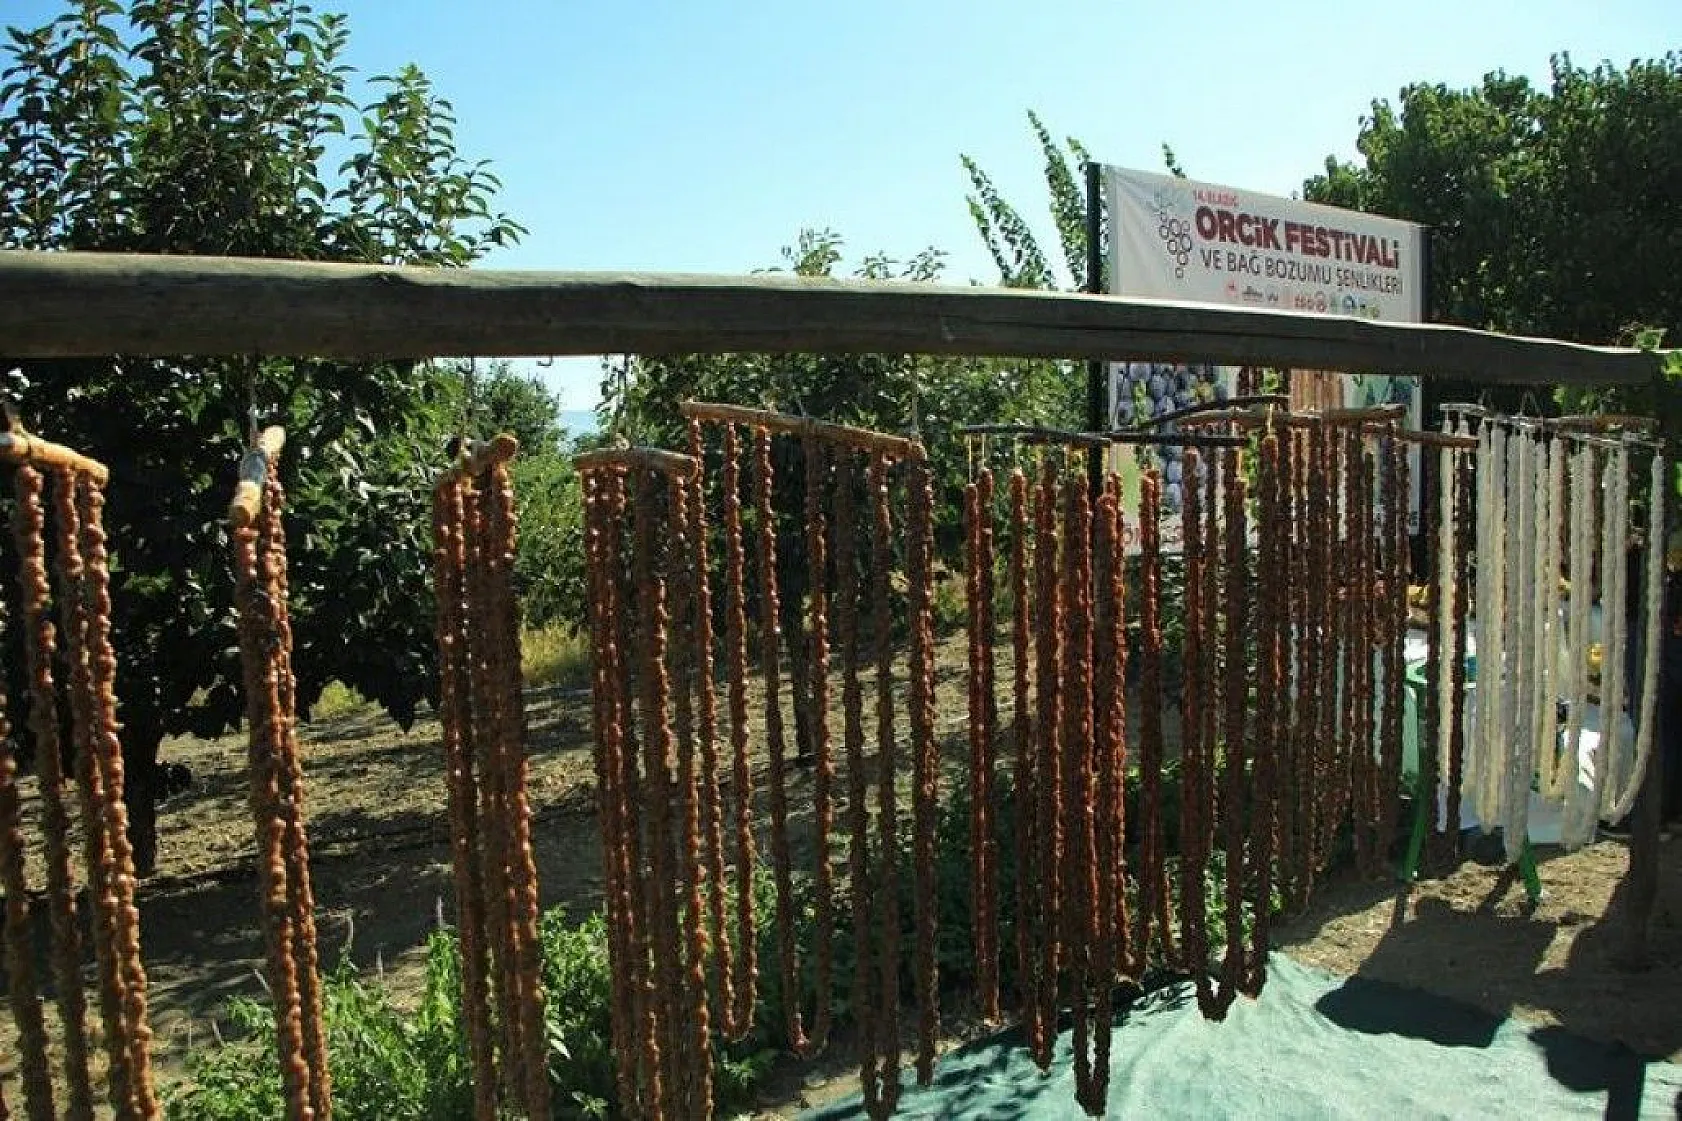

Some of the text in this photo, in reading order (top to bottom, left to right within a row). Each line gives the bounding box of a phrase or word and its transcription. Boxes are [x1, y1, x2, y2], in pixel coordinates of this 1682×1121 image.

[1200, 248, 1222, 269] VE
[1227, 250, 1260, 276] BAĞ
[1265, 256, 1331, 285] BOZUMU
